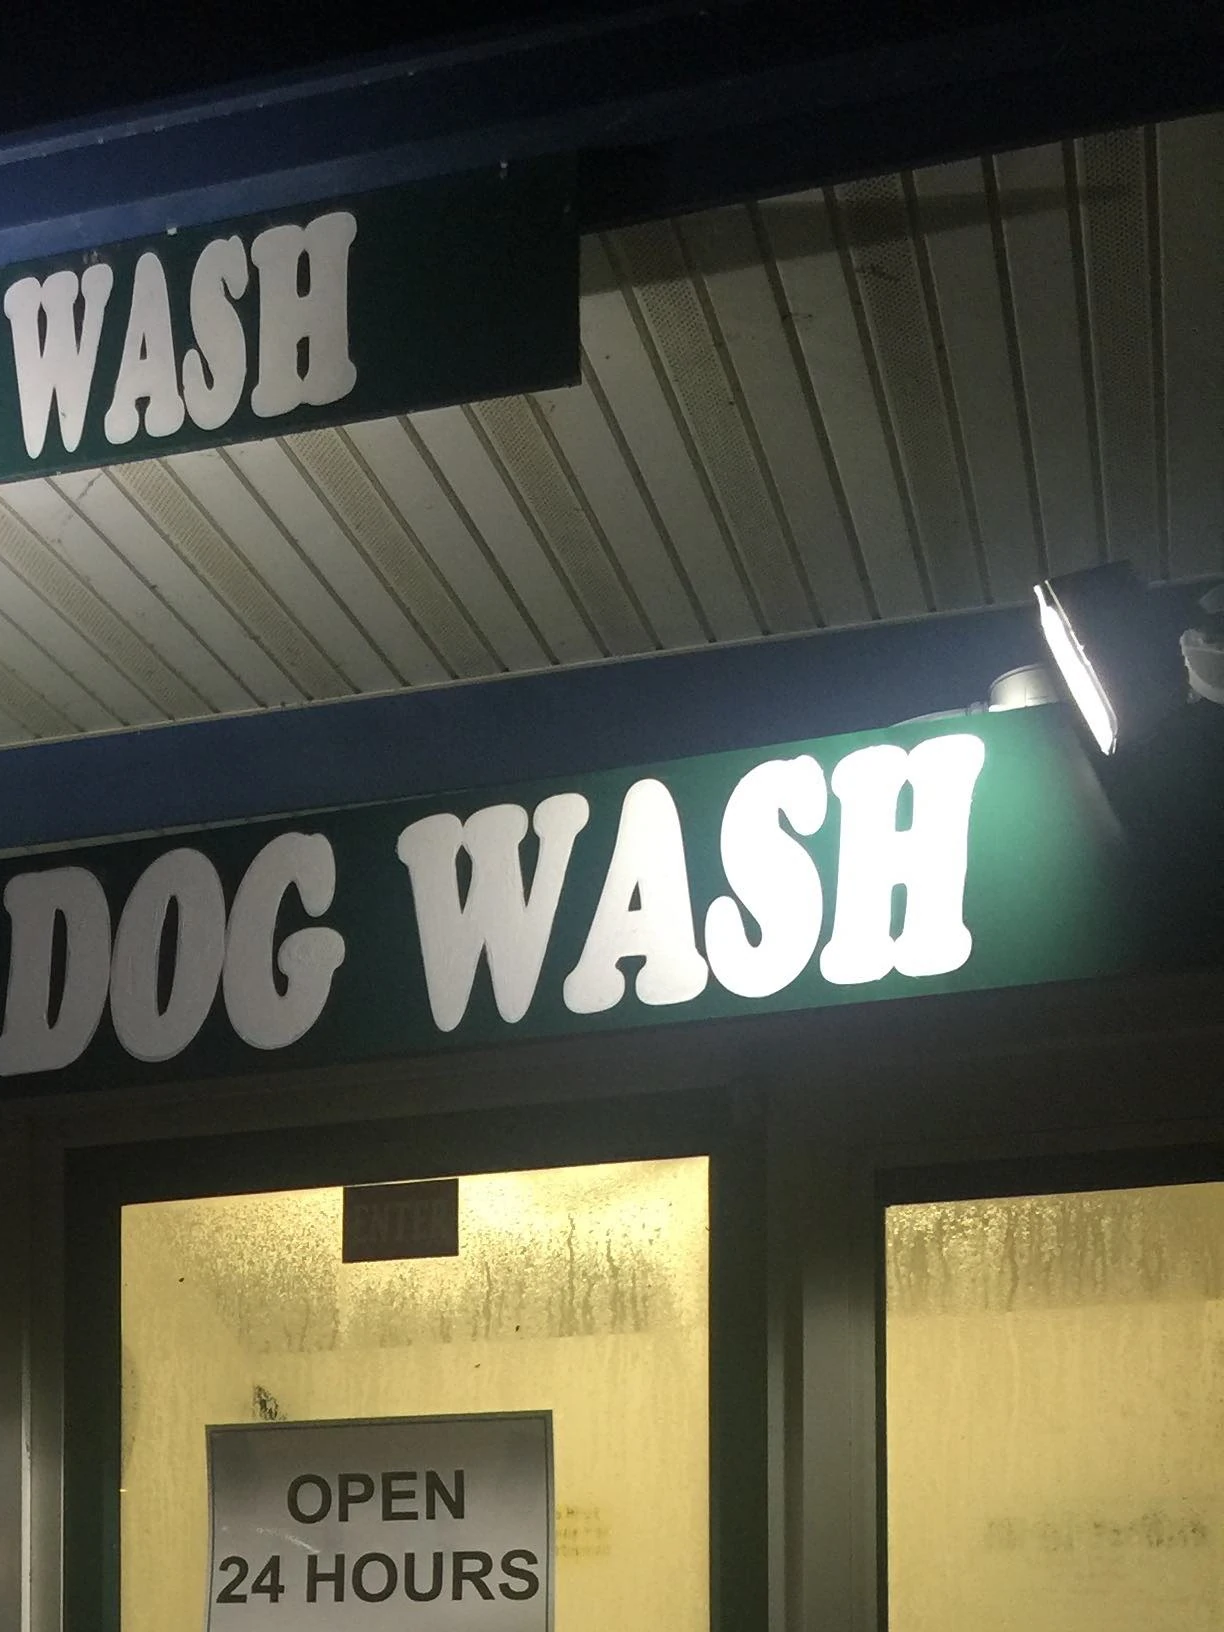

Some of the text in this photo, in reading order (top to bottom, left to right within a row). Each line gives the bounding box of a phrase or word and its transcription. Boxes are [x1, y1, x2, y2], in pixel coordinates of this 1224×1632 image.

[3, 210, 358, 460] WASH
[395, 732, 986, 1033] WASH
[286, 1469, 466, 1525] OPEN
[215, 1549, 540, 1605] 24 HOURS
